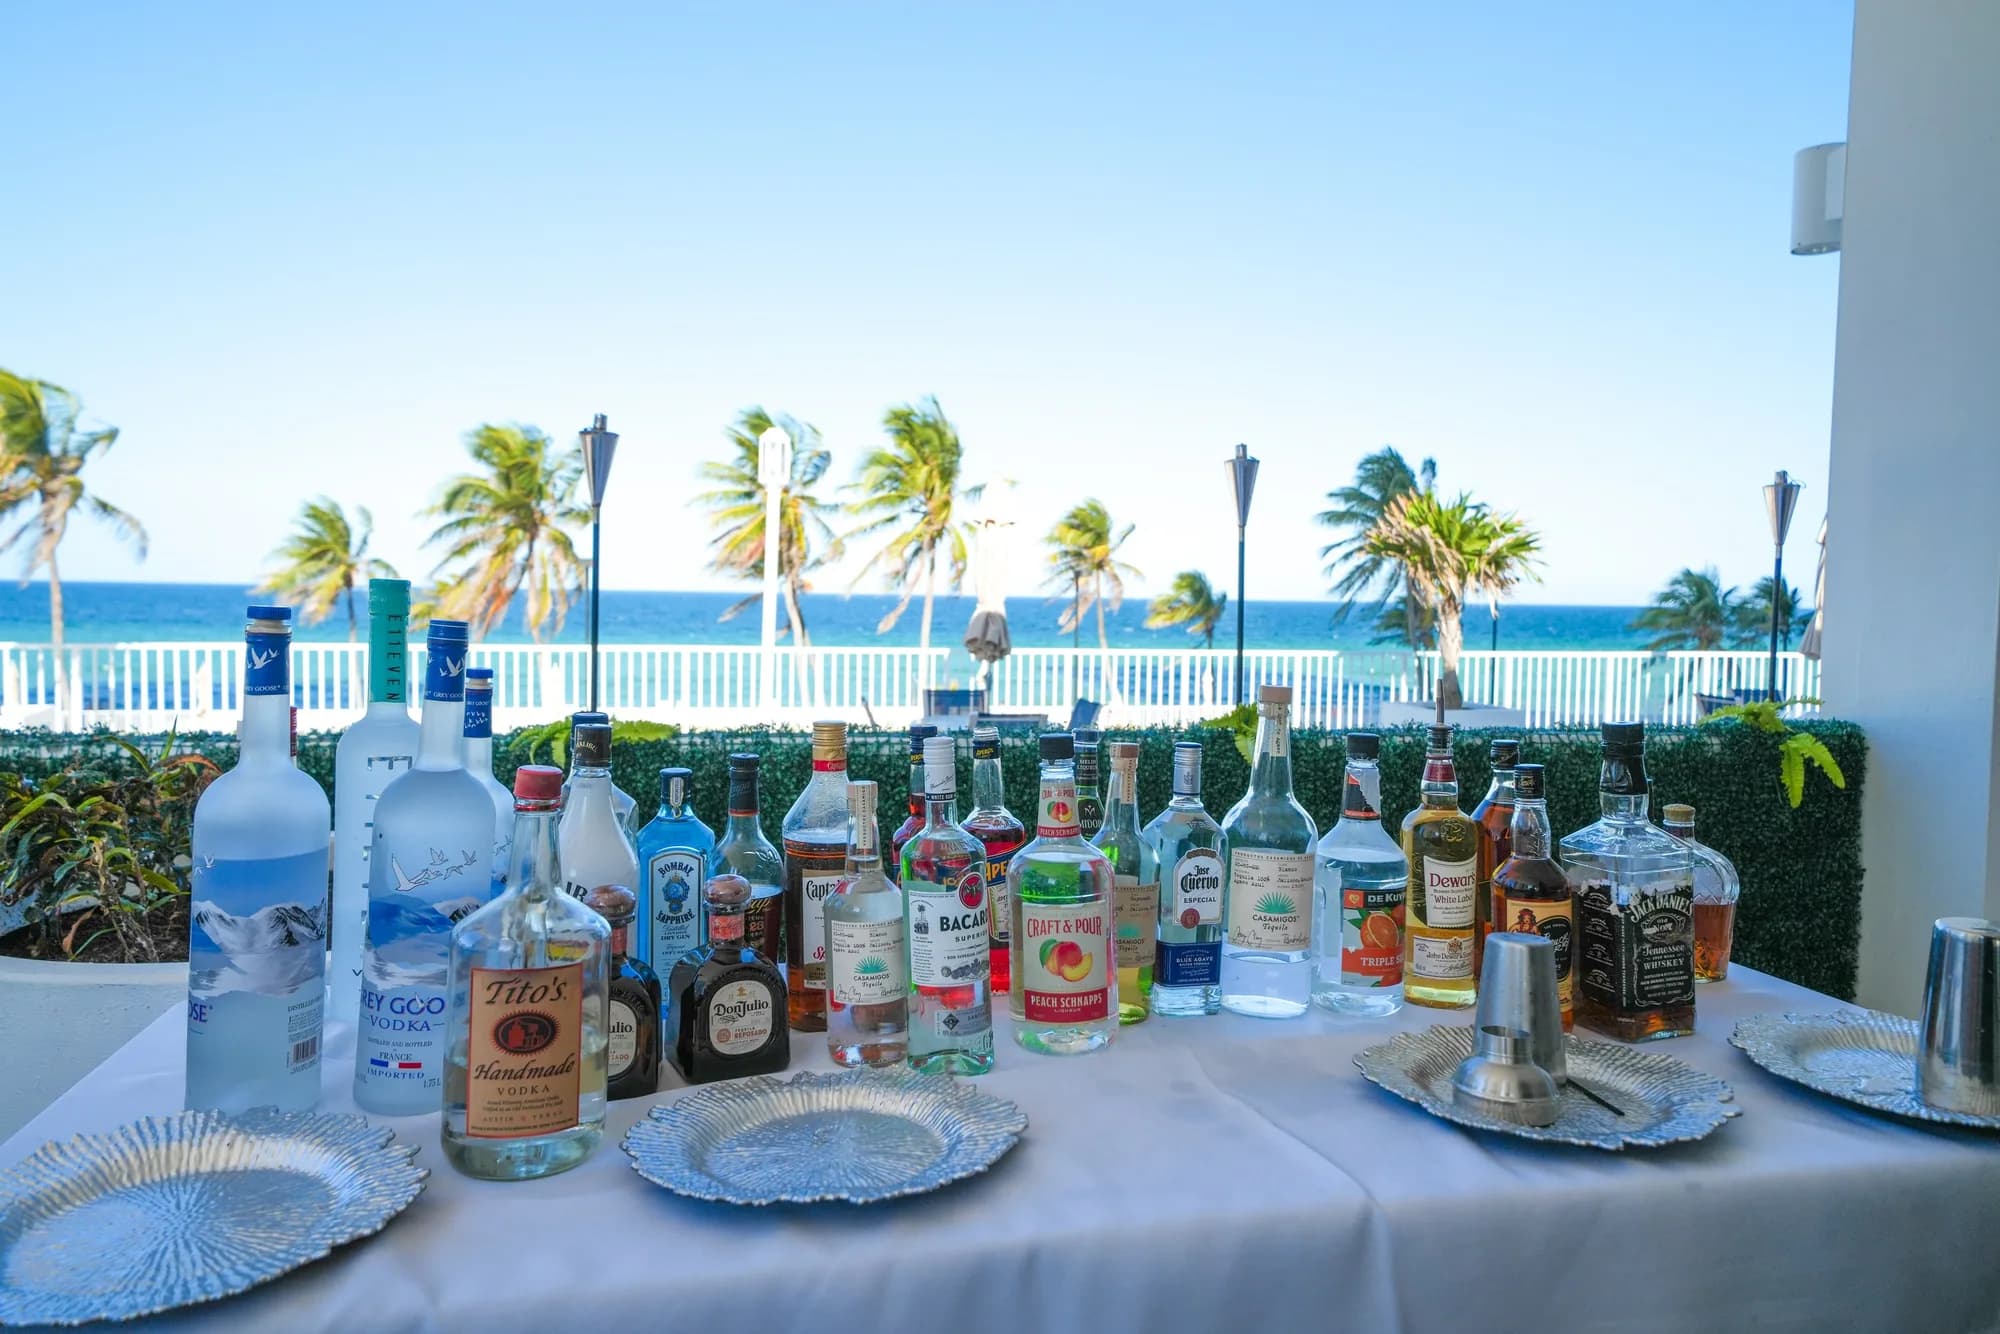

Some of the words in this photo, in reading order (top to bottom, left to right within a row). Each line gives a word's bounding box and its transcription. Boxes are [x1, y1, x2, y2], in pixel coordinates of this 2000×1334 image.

[657, 861, 695, 878] BOMBAY
[986, 861, 1008, 882] APE
[1193, 864, 1210, 876] Jose
[1180, 873, 1219, 893] Cuervo
[1183, 896, 1217, 904] ESPECIAL
[1630, 896, 1655, 923] JACK
[655, 909, 696, 925] SAPPHIRE
[1252, 914, 1297, 923] CASAMIGOS
[1027, 917, 1061, 938] CRAFT
[1062, 919, 1073, 933] &
[1075, 916, 1102, 936] POUR
[1262, 923, 1288, 932] Tequila
[1642, 944, 1686, 957] Tennessee
[1360, 956, 1395, 967] TRIPLE
[1643, 958, 1685, 971] WHISKEY
[485, 976, 567, 1006] Tito's
[1030, 994, 1058, 1008] PEACH
[1060, 992, 1103, 1008] SCHNAPPS
[369, 1015, 431, 1031] VODKA
[608, 1021, 633, 1035] ulio
[379, 1051, 413, 1061] FRANCE
[367, 1067, 425, 1080] IMPORTED
[473, 1052, 576, 1081] Handmade
[497, 1084, 550, 1097] VODKA
